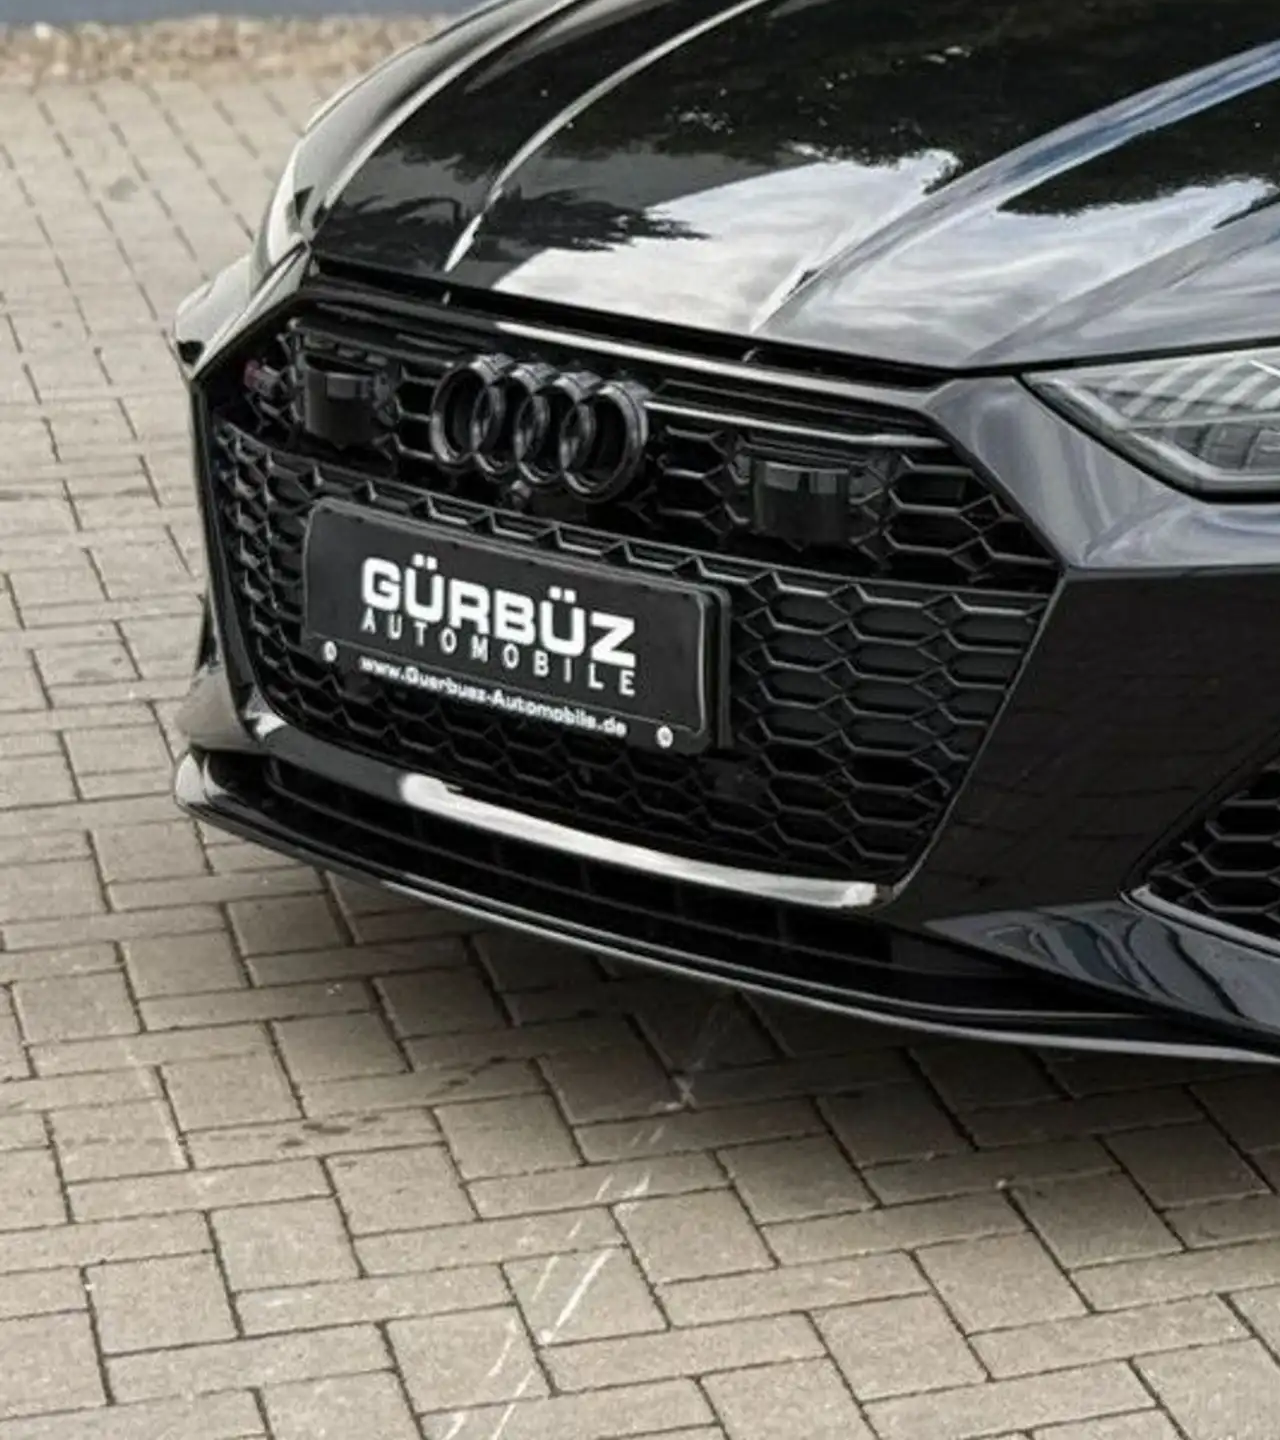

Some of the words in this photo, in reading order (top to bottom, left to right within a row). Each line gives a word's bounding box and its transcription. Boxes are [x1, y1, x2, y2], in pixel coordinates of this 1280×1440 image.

[360, 607, 636, 696] AUTOMOBILE
[361, 553, 636, 668] GÜRBÜZ
[359, 656, 628, 738] www.Guerbuez-Automobile.de
